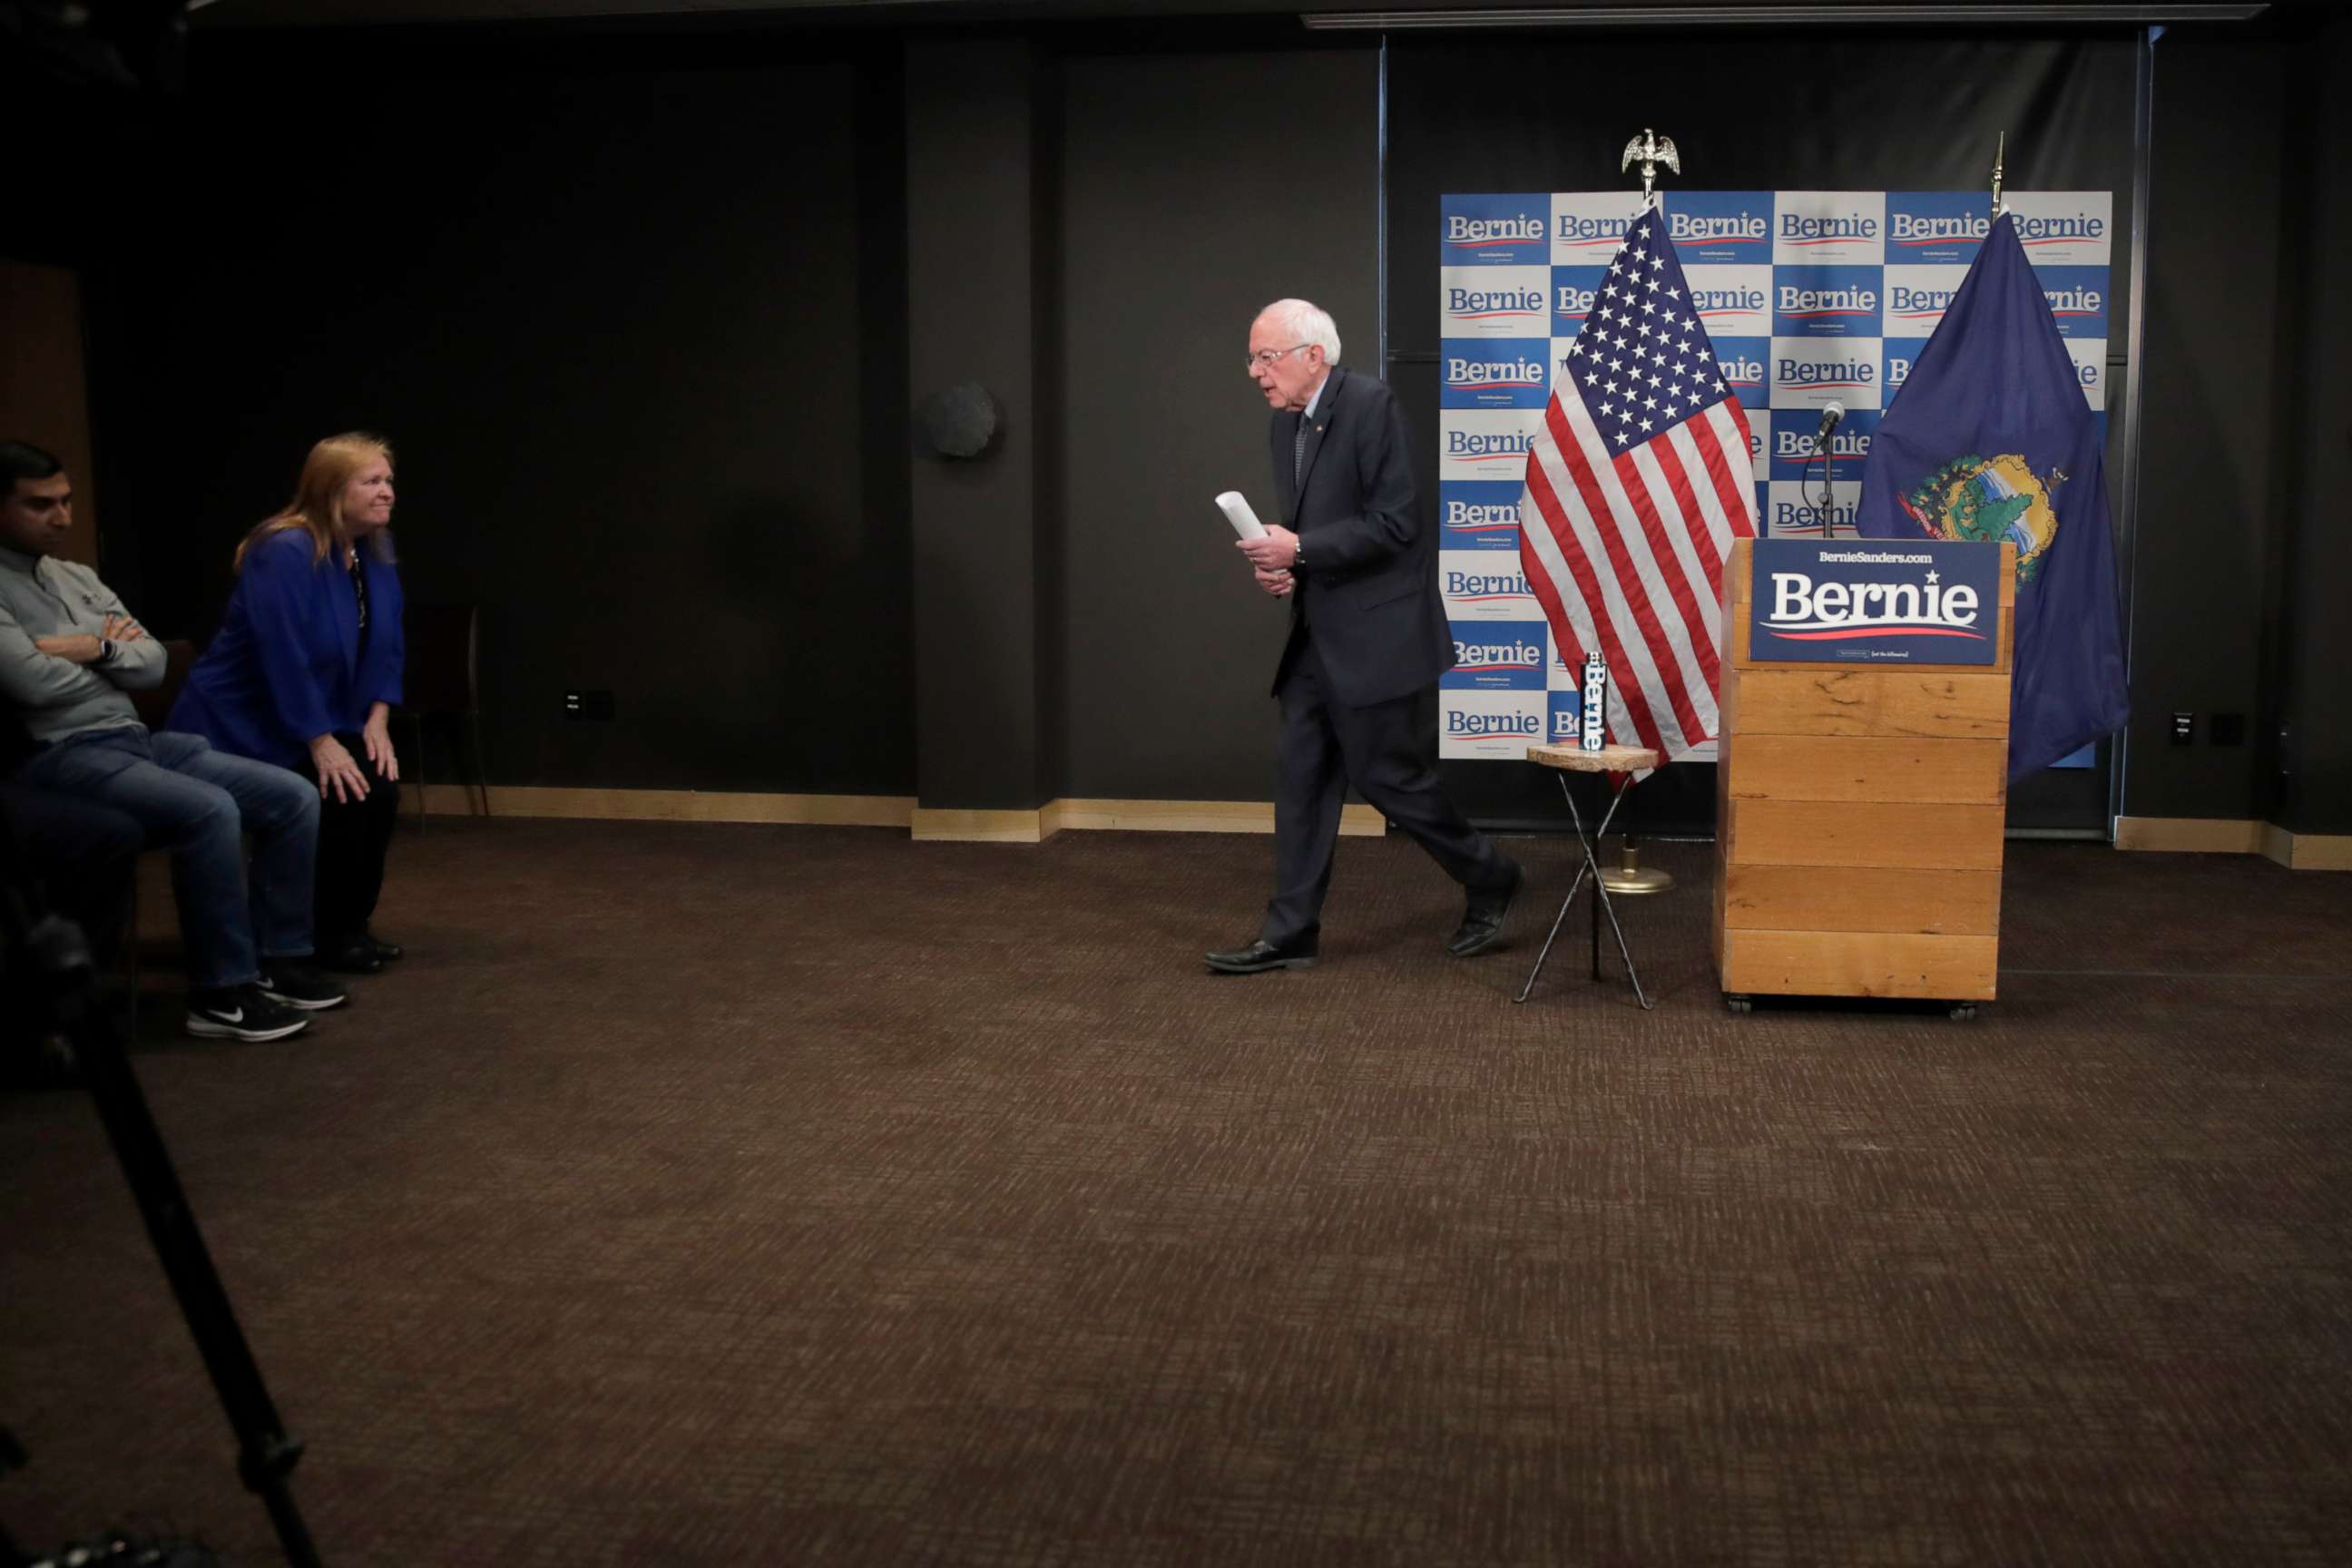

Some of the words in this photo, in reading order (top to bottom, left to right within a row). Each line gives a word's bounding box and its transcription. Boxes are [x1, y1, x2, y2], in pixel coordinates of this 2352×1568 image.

[1447, 212, 1544, 240] Bernie
[1670, 210, 1767, 238] Bernie
[1780, 212, 1877, 239] Bernie
[1892, 211, 1990, 238] Bernie
[1448, 286, 1543, 312] Bernie
[1690, 284, 1764, 309] ernie
[1779, 283, 1876, 310] Bernie
[1447, 356, 1544, 384] Bernie
[1778, 358, 1874, 383] Bernie
[1777, 428, 1871, 456] Benie
[1819, 551, 1933, 564] BernieSanders.com
[1770, 569, 1979, 626] Bernie
[1583, 664, 1606, 751] Bernie
[1446, 710, 1540, 733] Bernie
